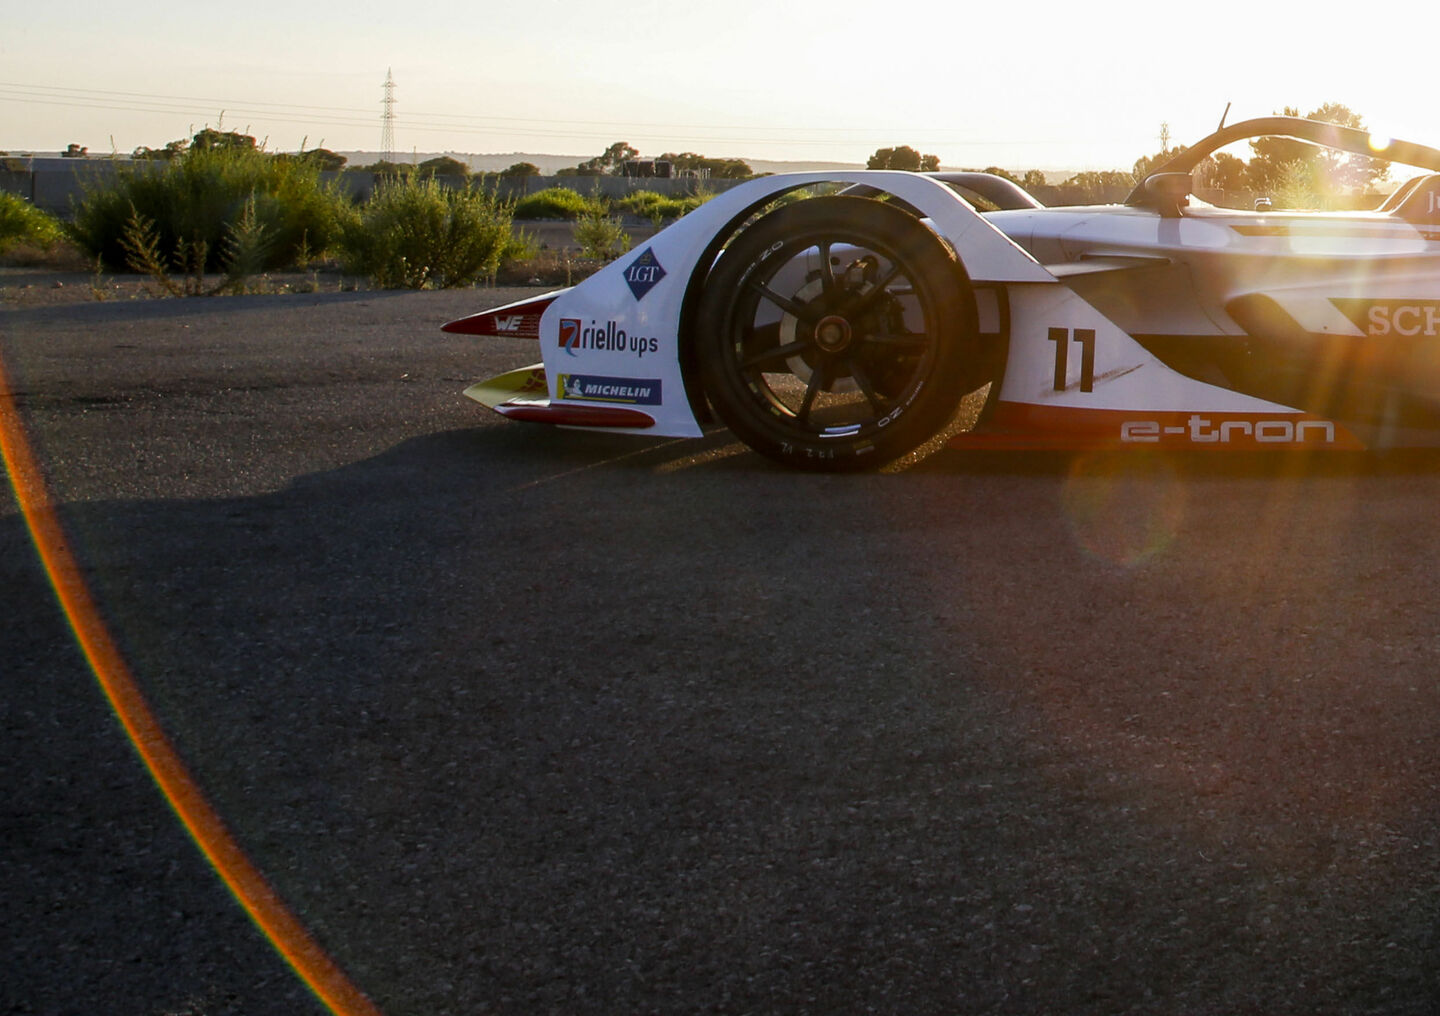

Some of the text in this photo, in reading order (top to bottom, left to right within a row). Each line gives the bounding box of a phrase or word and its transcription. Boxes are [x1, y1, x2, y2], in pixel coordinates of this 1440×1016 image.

[627, 265, 660, 283] LGT
[582, 320, 658, 358] riello ups
[1048, 327, 1096, 393] 11
[584, 384, 651, 398] MICHELIN
[1120, 414, 1335, 444] e-tron
